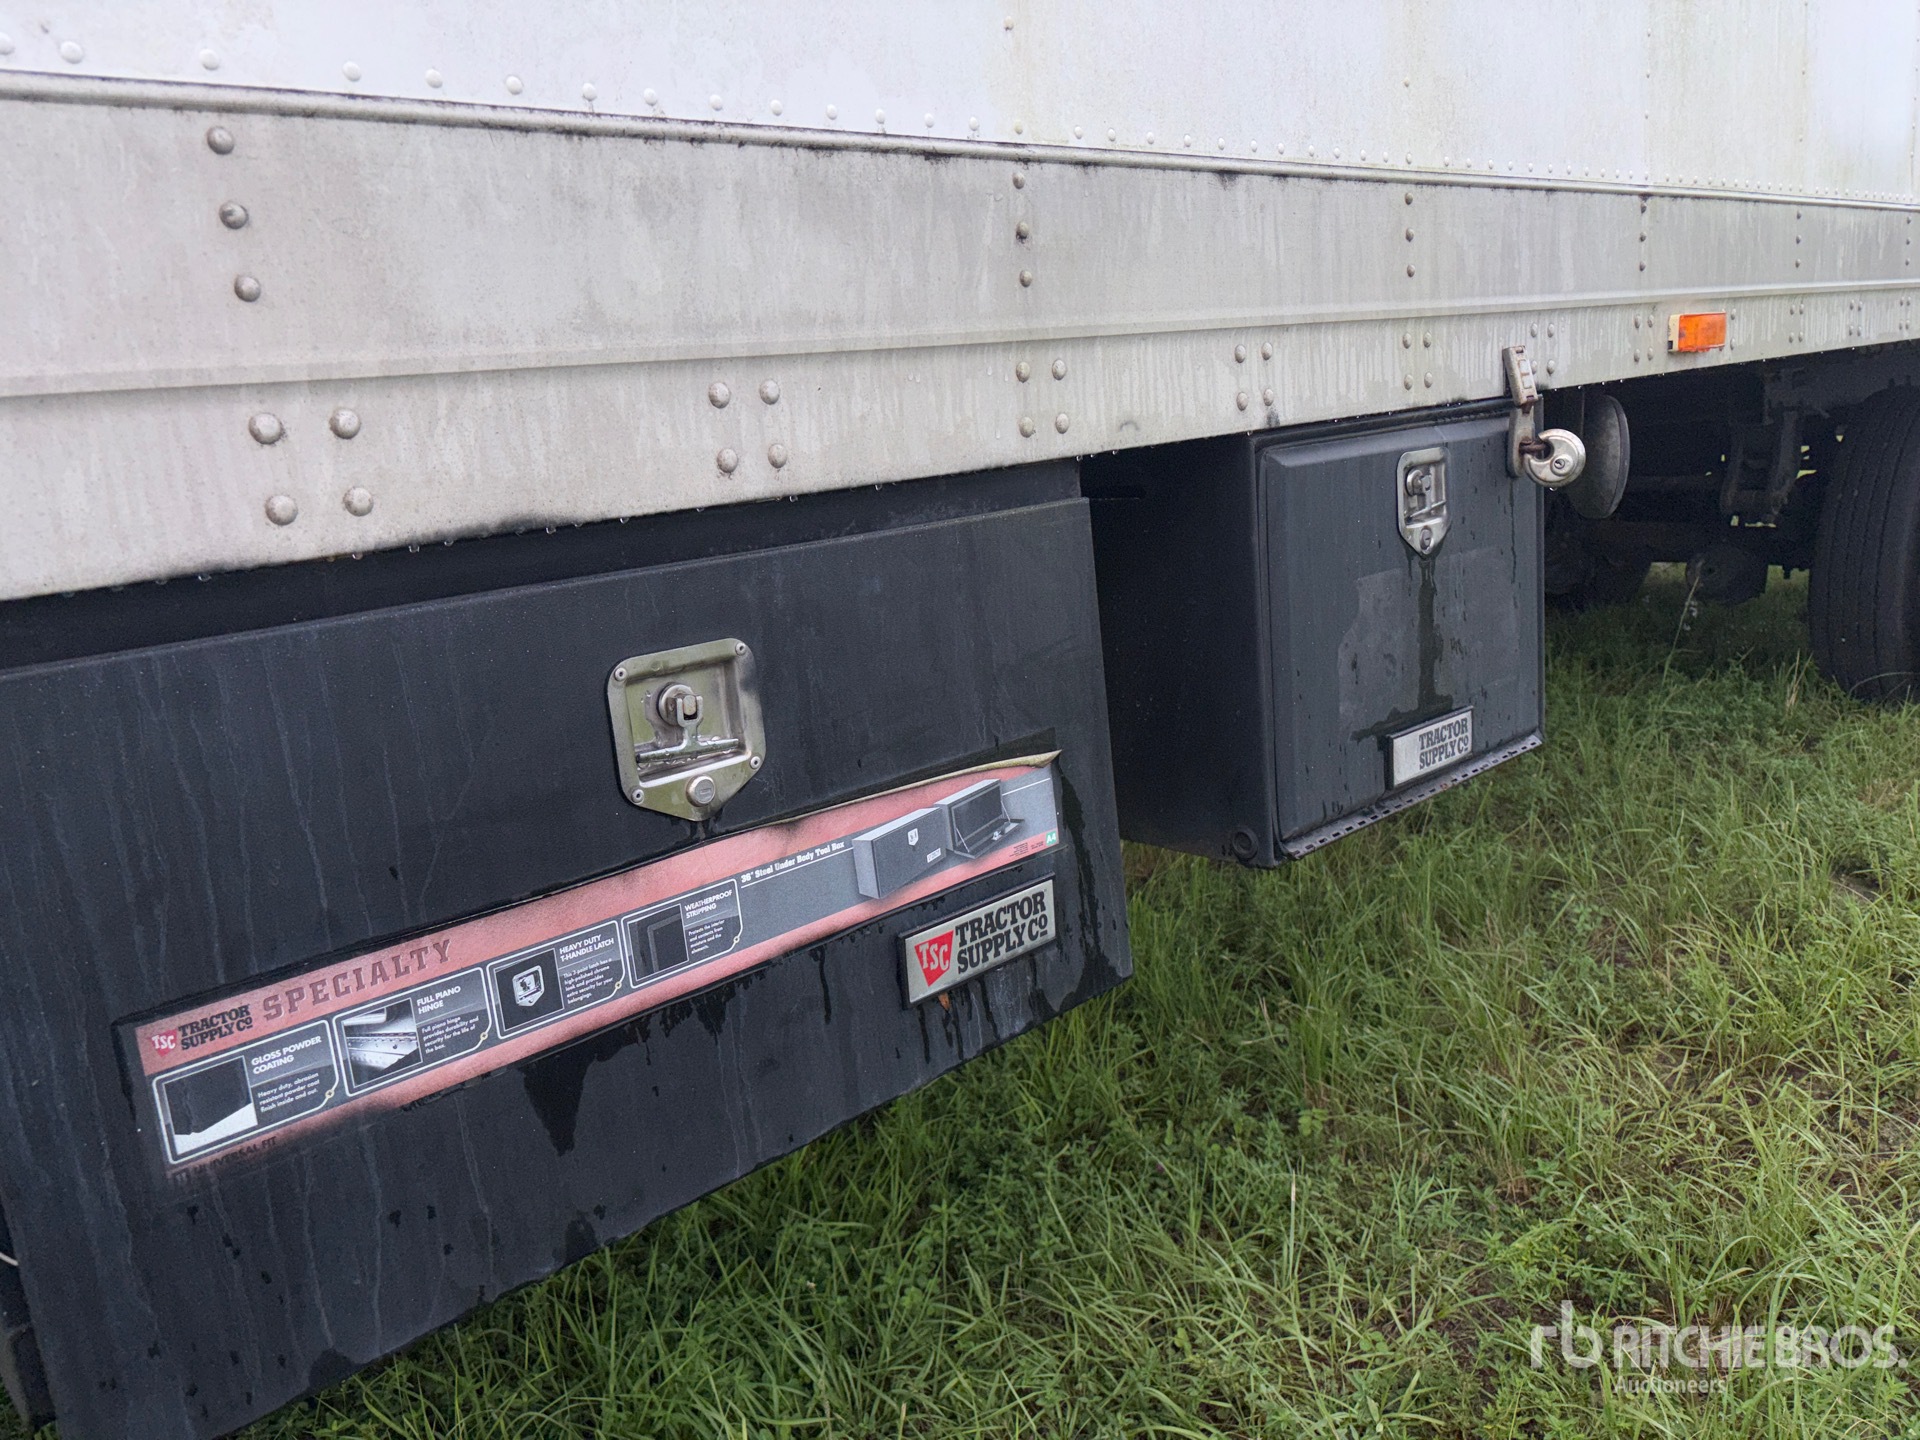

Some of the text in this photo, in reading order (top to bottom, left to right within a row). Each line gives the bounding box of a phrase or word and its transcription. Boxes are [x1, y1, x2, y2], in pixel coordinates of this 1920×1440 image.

[1419, 718, 1468, 750] TRACTOR
[1419, 740, 1456, 770] SUPPLY
[1046, 832, 1056, 844] A4
[755, 865, 773, 878] Steel
[774, 858, 795, 871] Under
[796, 852, 814, 863] Body
[815, 845, 831, 857] Tool
[831, 841, 845, 851] Box
[684, 889, 732, 911] WEATHERPROOF
[686, 903, 717, 918] STRIPPING
[955, 891, 1046, 947] TRACTOR
[559, 934, 601, 954] HEAVY DUTY
[560, 938, 614, 962] T-HANDLE LATCH
[957, 923, 1026, 974] SUPPLY
[919, 942, 949, 971] TSC
[263, 939, 451, 1021] SPECIALTY
[417, 986, 461, 1006] FULL PIANO
[418, 1000, 444, 1014] HINGE
[178, 1005, 250, 1037] TRACTOR
[423, 1030, 444, 1041] provides
[445, 1021, 468, 1032] durability
[432, 1022, 446, 1030] piano
[152, 1035, 176, 1049] TSC
[181, 1022, 234, 1050] SUPPLY
[425, 1037, 443, 1047] security
[251, 1036, 322, 1065] GLOSS POWDER
[253, 1055, 294, 1074] COATING
[258, 1087, 277, 1098] Heavy
[294, 1073, 319, 1084] abrasion
[284, 1085, 306, 1097] powder
[307, 1079, 319, 1087] coat
[277, 1098, 294, 1106] inside
[295, 1091, 306, 1100] and
